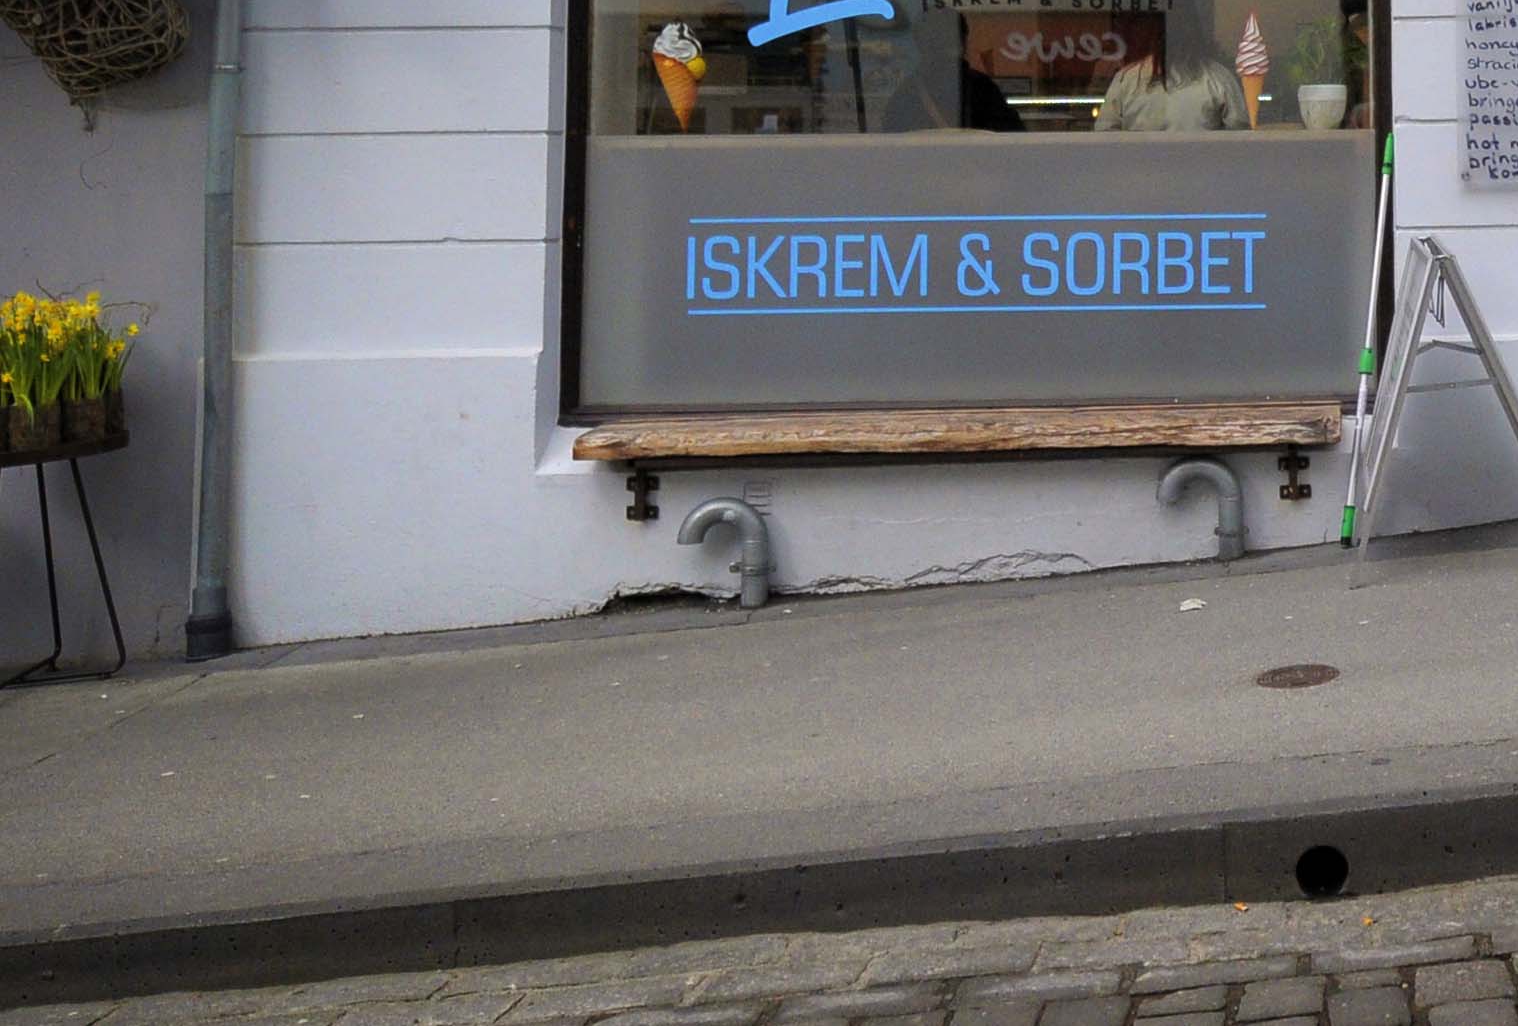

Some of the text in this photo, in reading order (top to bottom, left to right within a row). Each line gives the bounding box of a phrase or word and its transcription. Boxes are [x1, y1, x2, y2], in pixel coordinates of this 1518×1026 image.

[1466, 133, 1499, 150] hot
[686, 231, 1265, 299] ISKREM & SORBET
